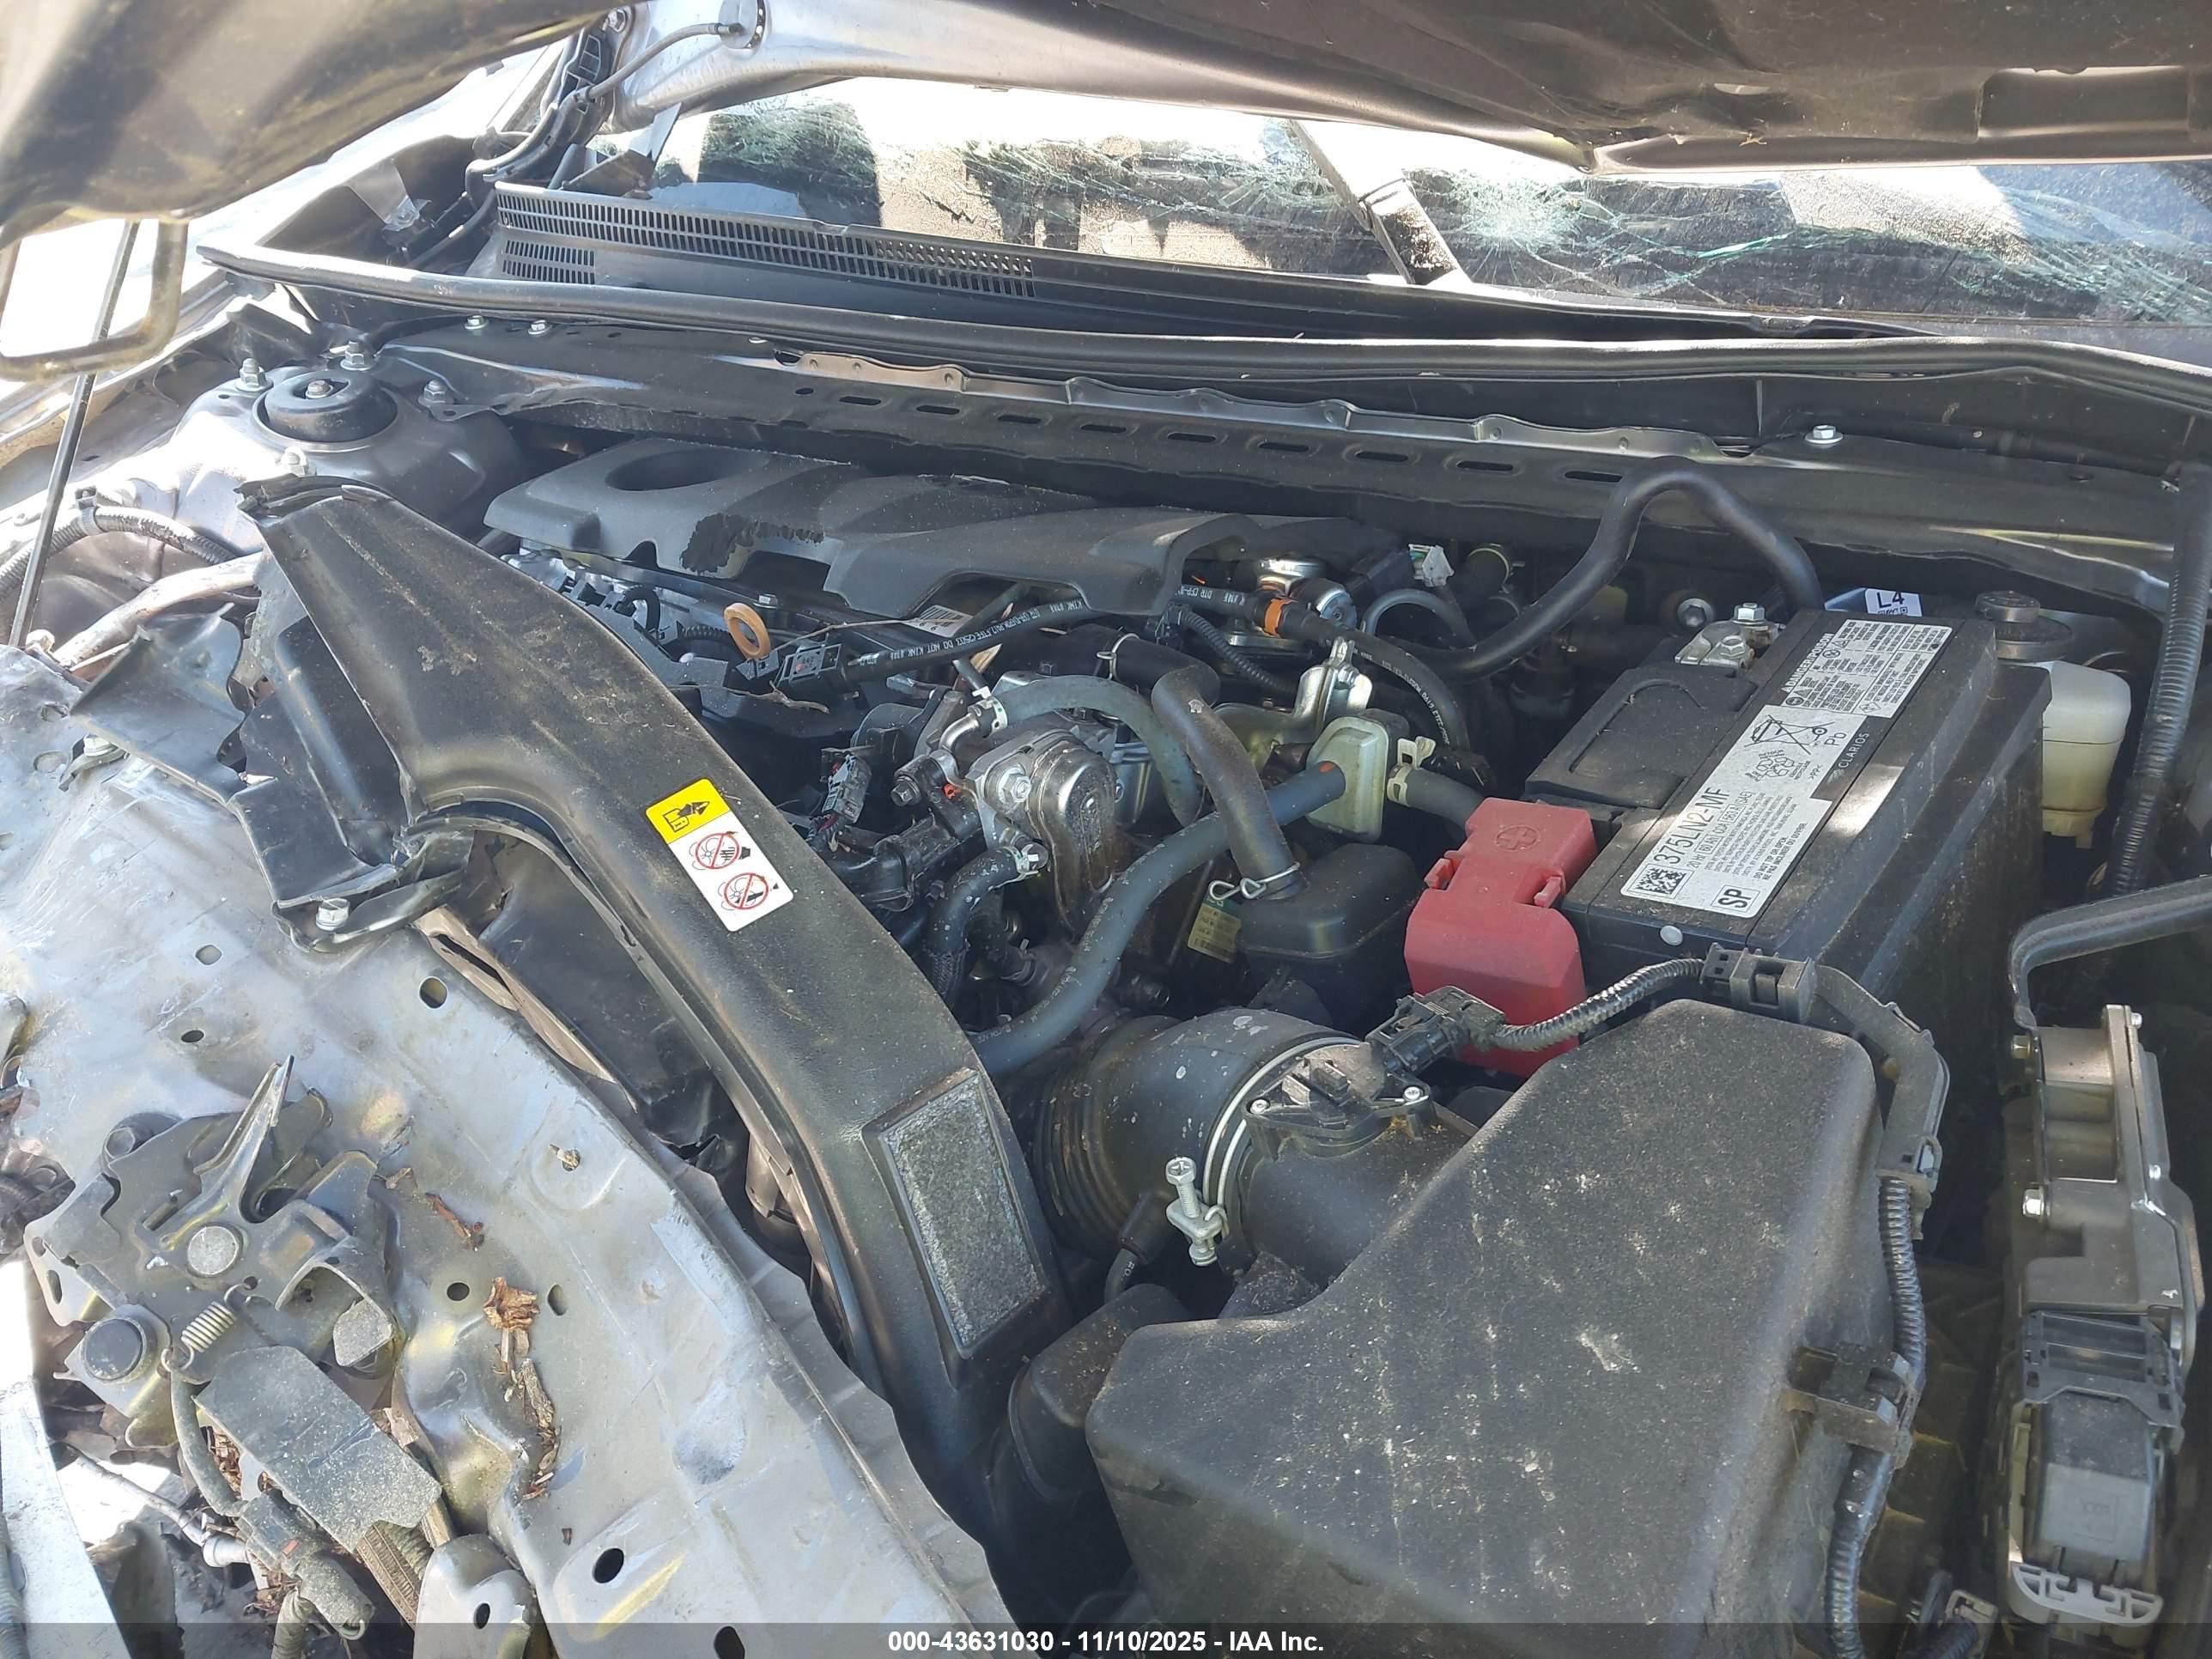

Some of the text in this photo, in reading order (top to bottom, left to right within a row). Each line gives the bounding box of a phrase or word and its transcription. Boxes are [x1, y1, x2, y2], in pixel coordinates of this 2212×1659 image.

[1876, 591, 1905, 609] L4
[927, 643, 941, 653] NOT
[943, 640, 954, 650] DO
[1786, 633, 1835, 690] DANGER/POISON
[1824, 732, 1847, 746] Pb
[1838, 732, 1869, 769] CLARIOS
[1735, 791, 1757, 806] (SAE)
[1653, 787, 1730, 864] 375LN2-MF
[1717, 888, 1753, 908] SP
